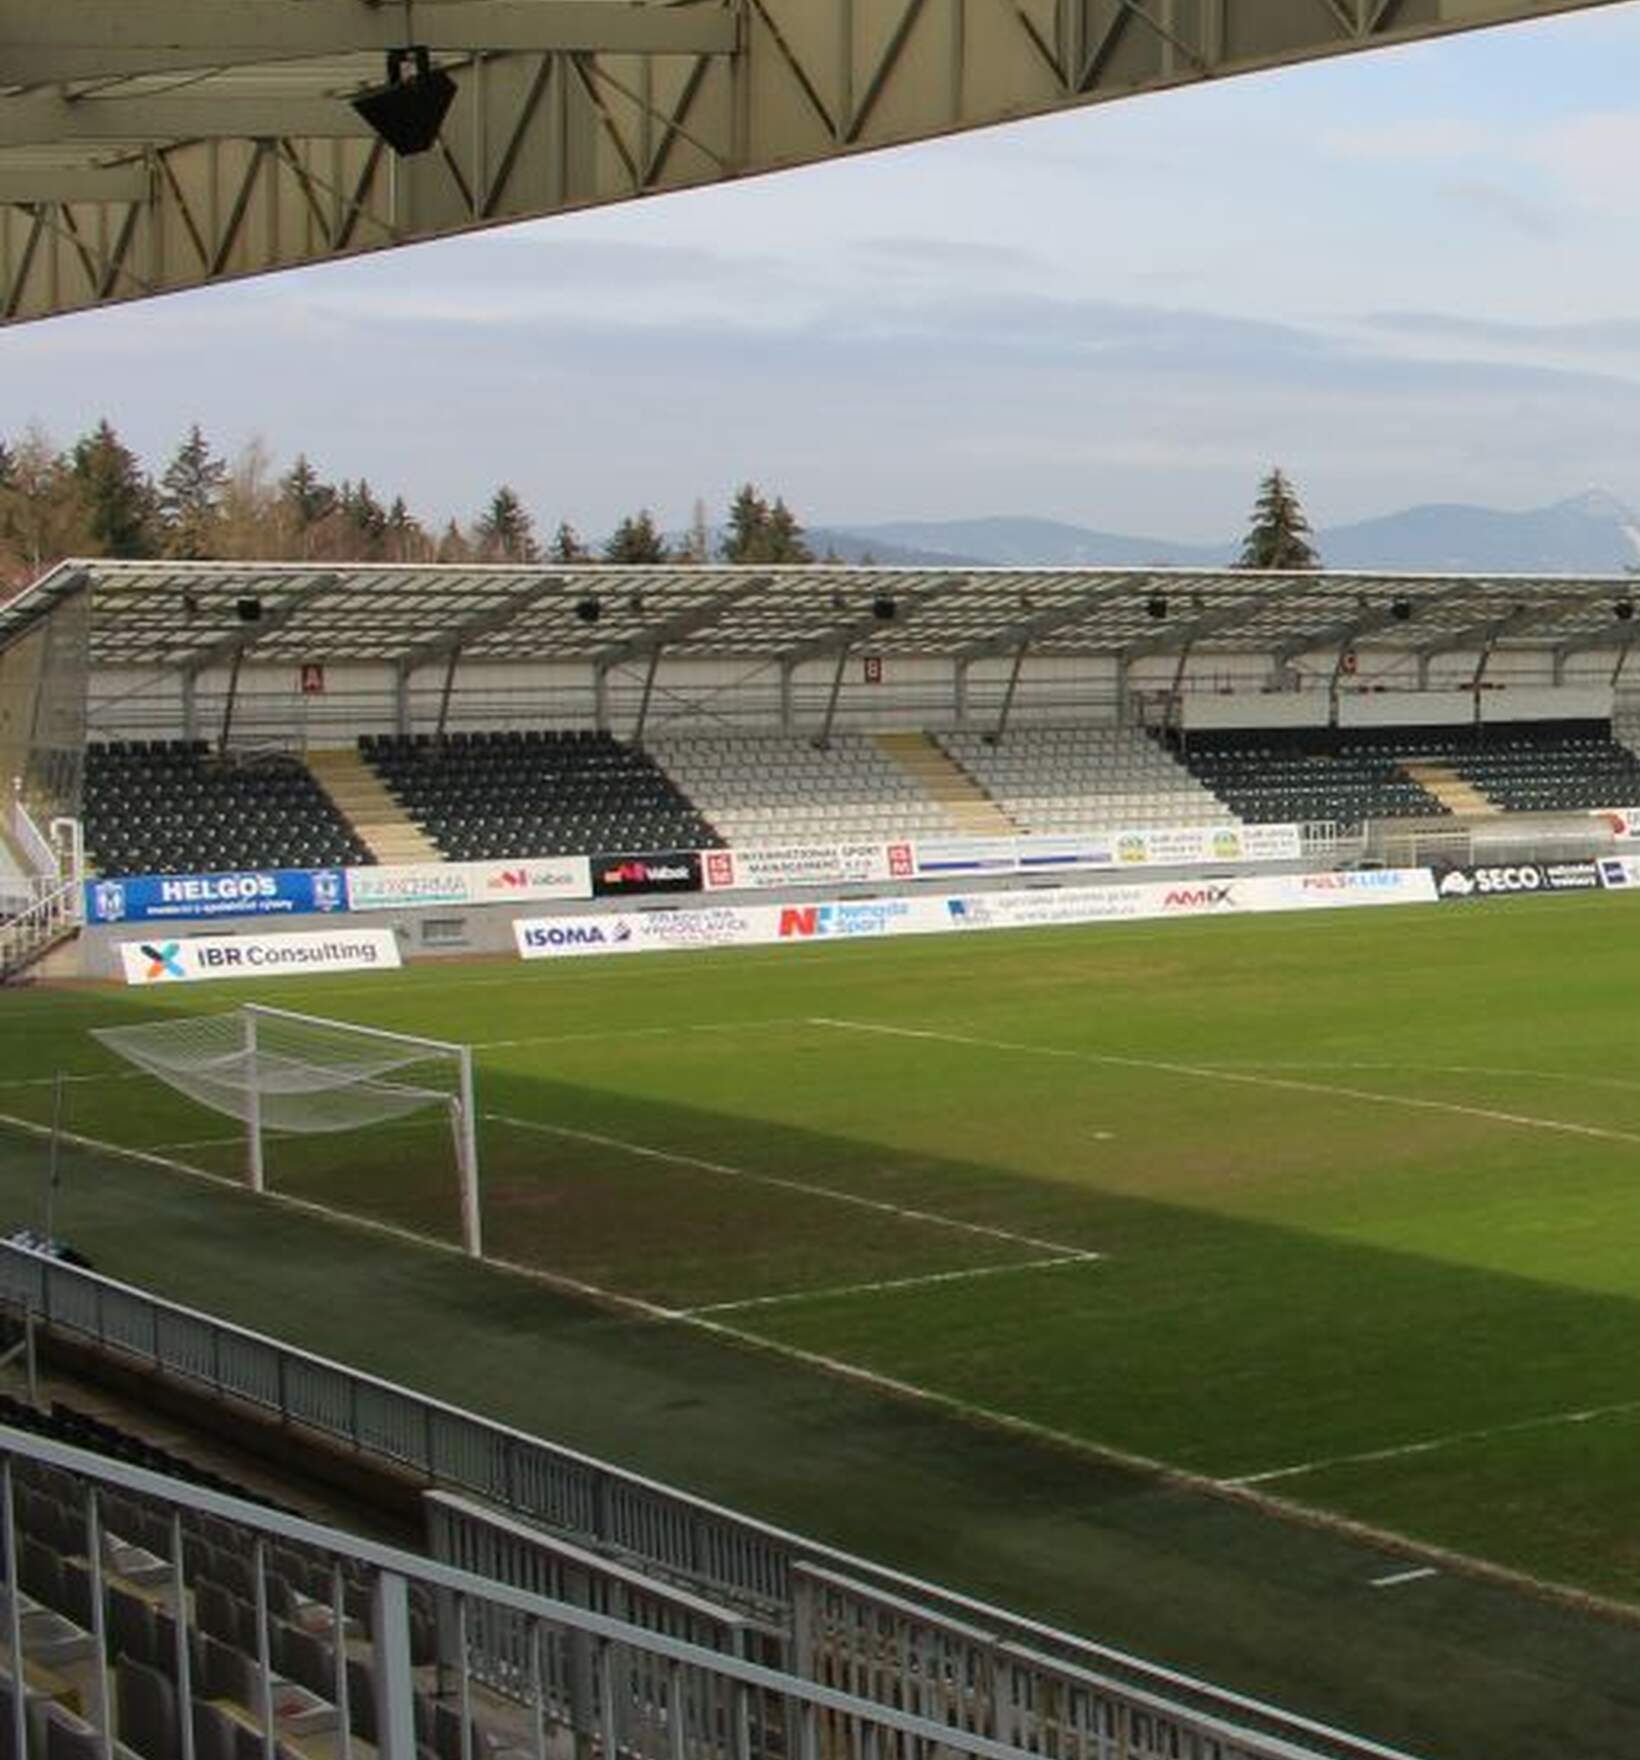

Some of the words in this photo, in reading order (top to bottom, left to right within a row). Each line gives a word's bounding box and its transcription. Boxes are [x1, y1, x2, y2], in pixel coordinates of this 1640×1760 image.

[162, 877, 278, 903] HELGOS
[1475, 866, 1540, 892] SECO
[1164, 885, 1236, 906] AMIX
[525, 926, 605, 947] ISOMA
[198, 947, 242, 968] IBR
[247, 942, 377, 965] Consulting
